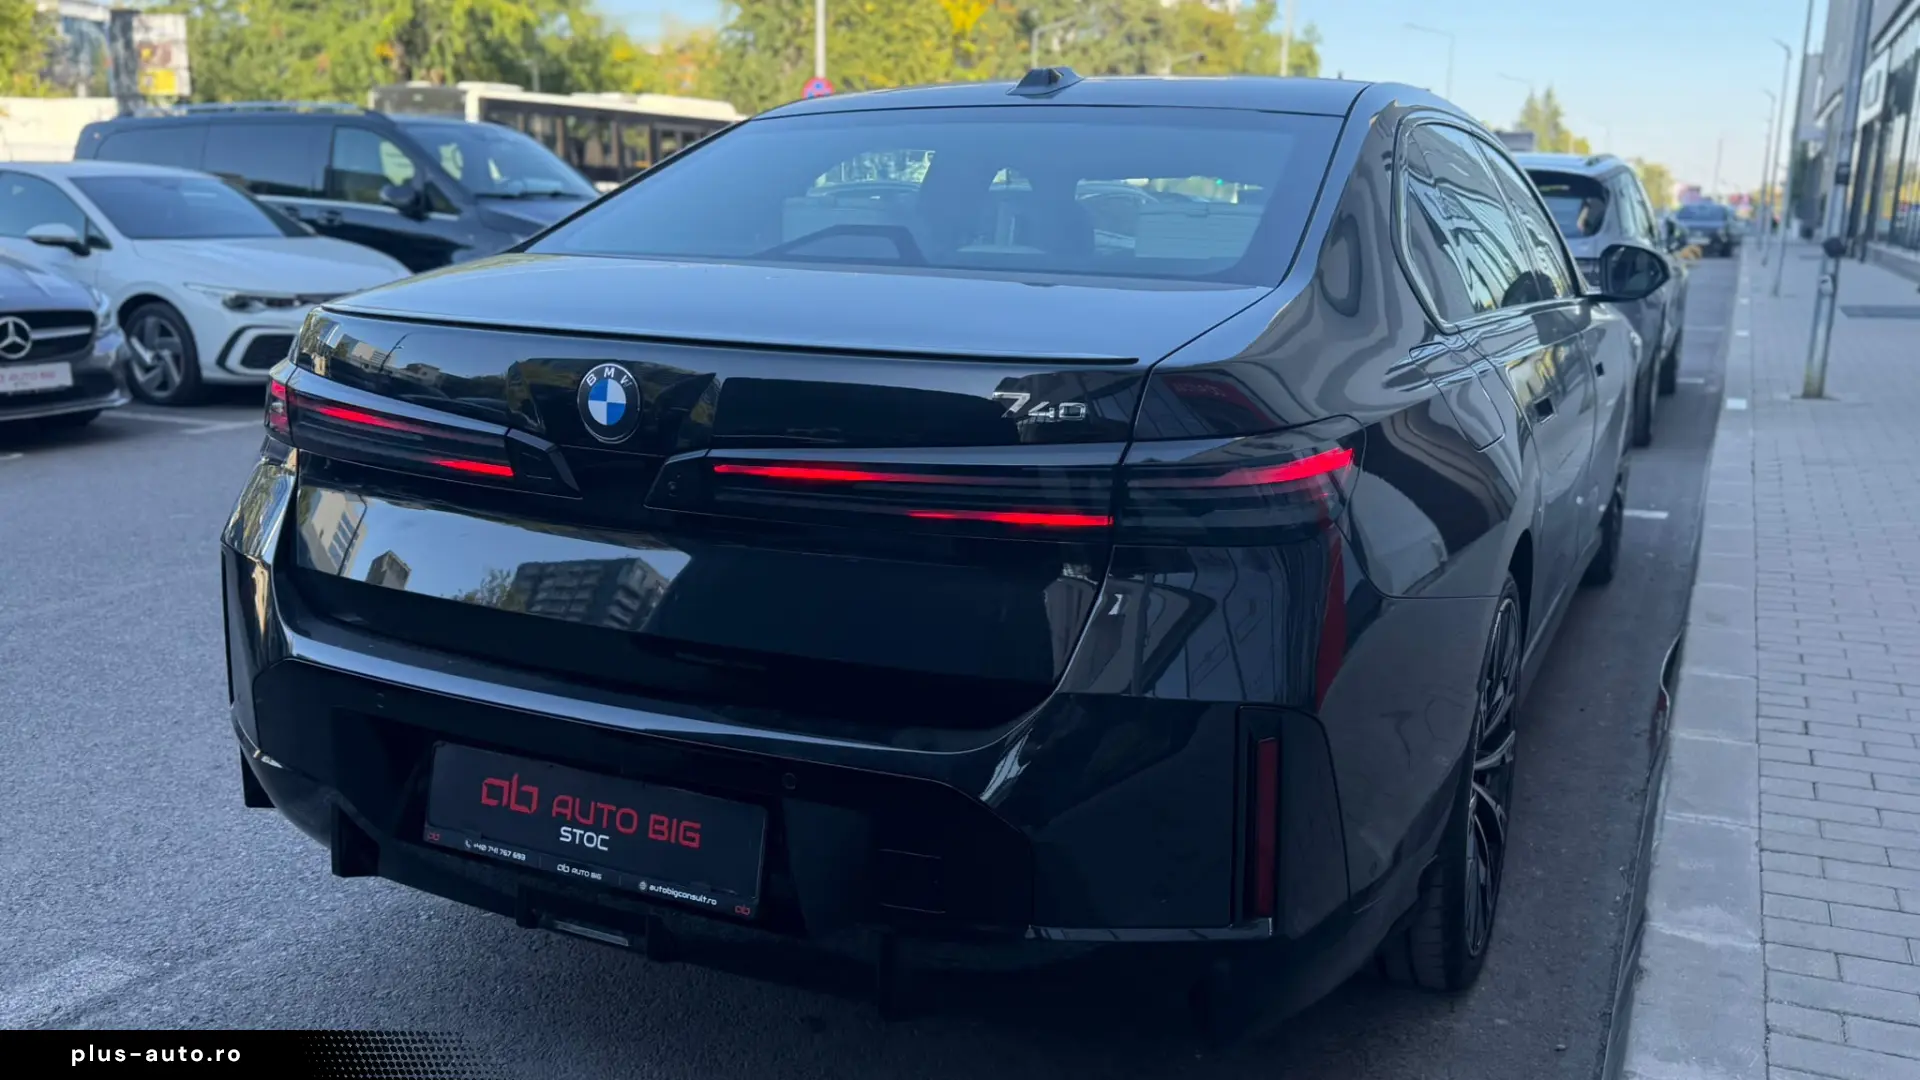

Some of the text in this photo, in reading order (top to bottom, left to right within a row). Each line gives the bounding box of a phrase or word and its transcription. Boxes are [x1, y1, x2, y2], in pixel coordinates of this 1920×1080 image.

[586, 367, 633, 388] BMW
[991, 391, 1086, 421] 740
[552, 795, 639, 834] AUTO
[648, 813, 701, 848] BIG
[559, 826, 610, 851] STOC
[571, 867, 590, 877] AUTO
[590, 872, 602, 880] BIG
[649, 884, 717, 905] autobigconsult.ro
